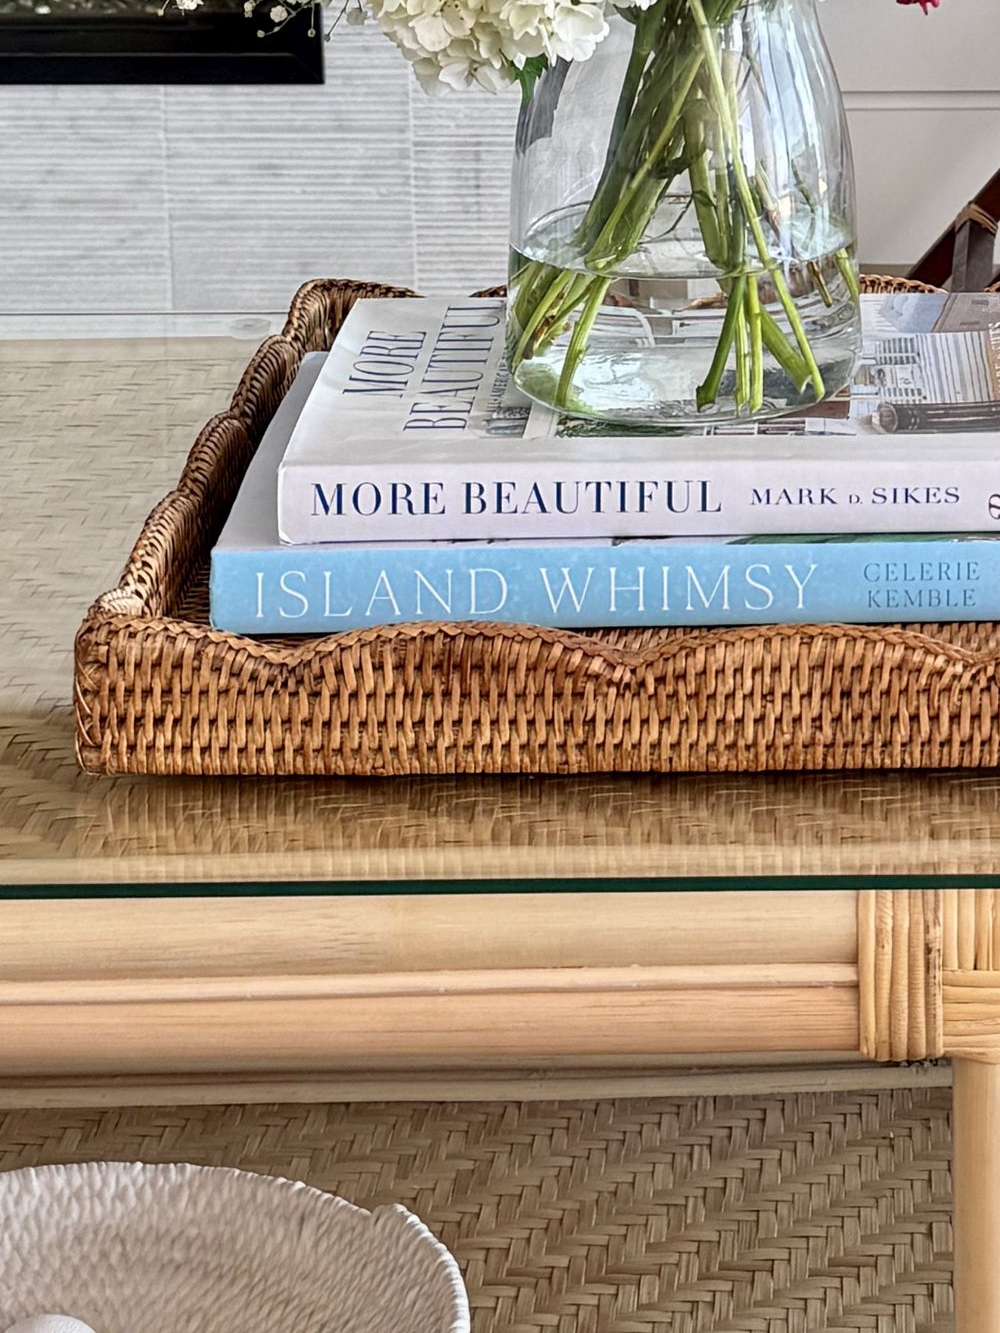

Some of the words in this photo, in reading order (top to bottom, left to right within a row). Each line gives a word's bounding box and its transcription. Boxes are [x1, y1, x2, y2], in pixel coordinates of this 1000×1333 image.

[342, 331, 426, 398] MORE
[403, 301, 506, 431] BEAUTIFUL
[311, 482, 446, 516] MORE
[462, 480, 722, 515] BEAUTIFUL
[750, 487, 838, 506] MARK
[871, 486, 961, 505] SIKES
[863, 562, 981, 583] CELERIE
[256, 568, 508, 619] ISLAND
[539, 564, 818, 614] WHIMSY
[867, 588, 977, 609] KEMBLE
